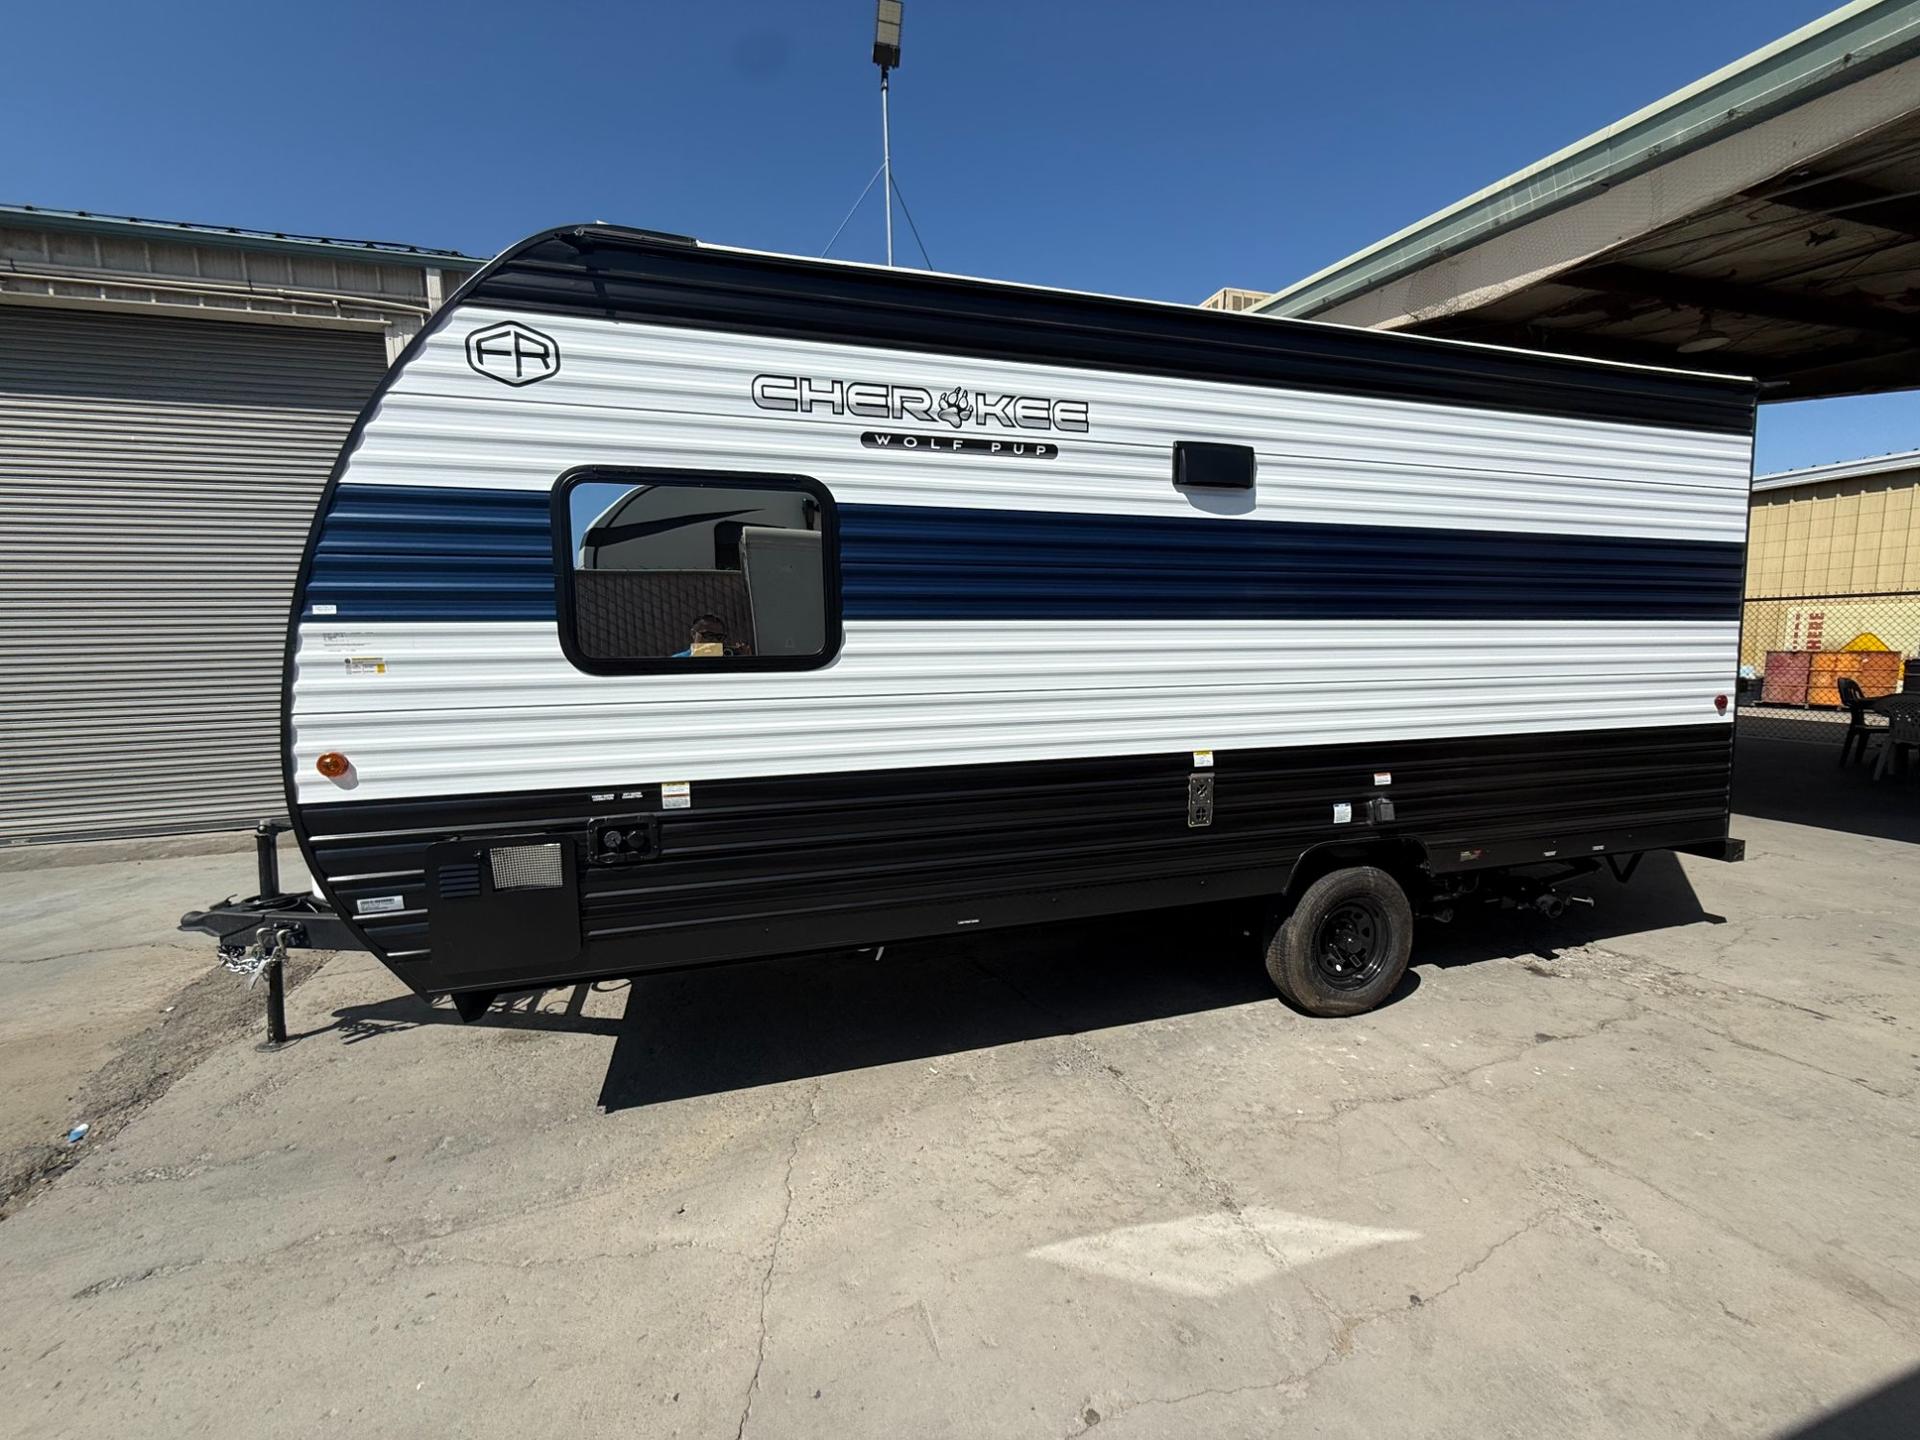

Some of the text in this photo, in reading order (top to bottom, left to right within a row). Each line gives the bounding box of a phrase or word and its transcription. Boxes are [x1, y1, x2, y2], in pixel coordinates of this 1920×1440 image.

[752, 374, 1089, 433] CHEROKEE
[875, 434, 1047, 456] WOLF PUP
[1806, 613, 1824, 650] HERE
